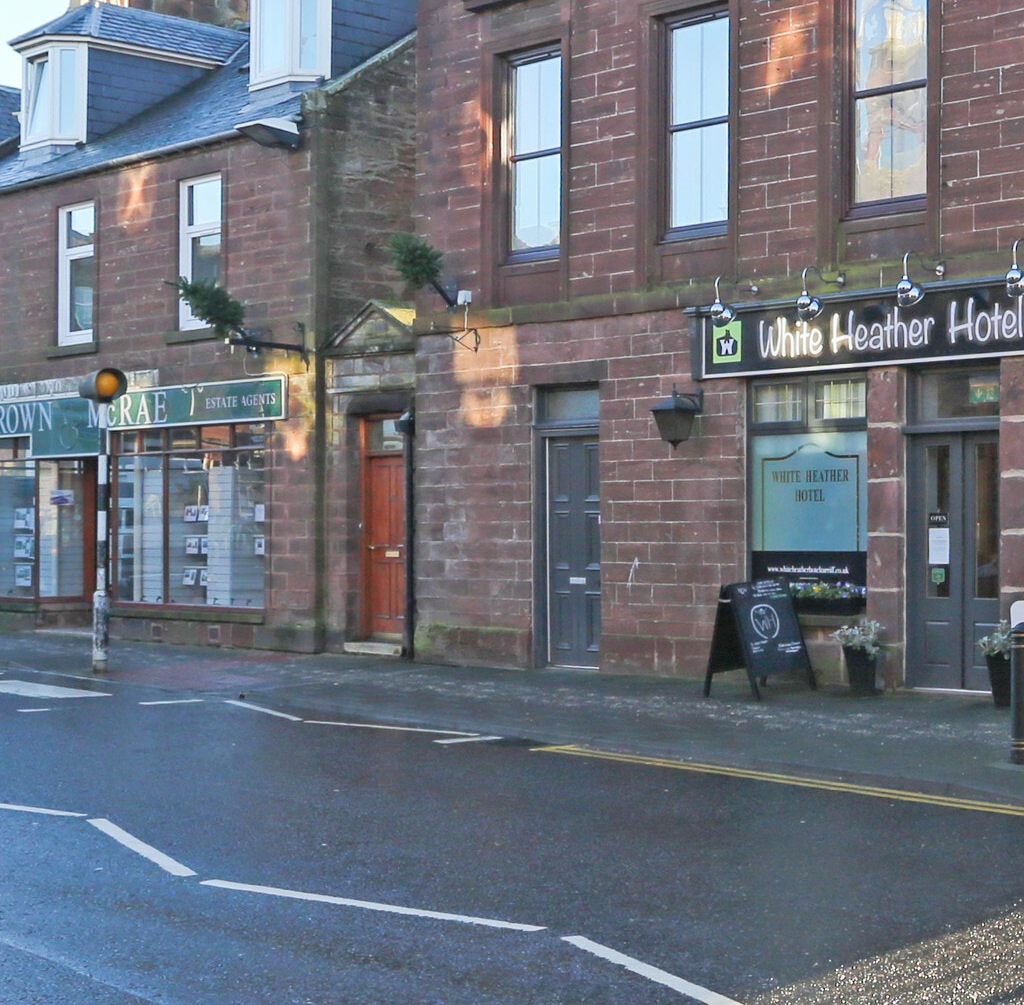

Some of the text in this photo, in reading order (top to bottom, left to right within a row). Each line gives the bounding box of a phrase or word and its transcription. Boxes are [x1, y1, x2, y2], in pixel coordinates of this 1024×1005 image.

[759, 296, 1024, 359] White Heather Hotel
[205, 392, 276, 410] ESTATE AGENTS
[772, 468, 849, 483] WHITE HEATHER
[795, 488, 825, 502] HOTEL
